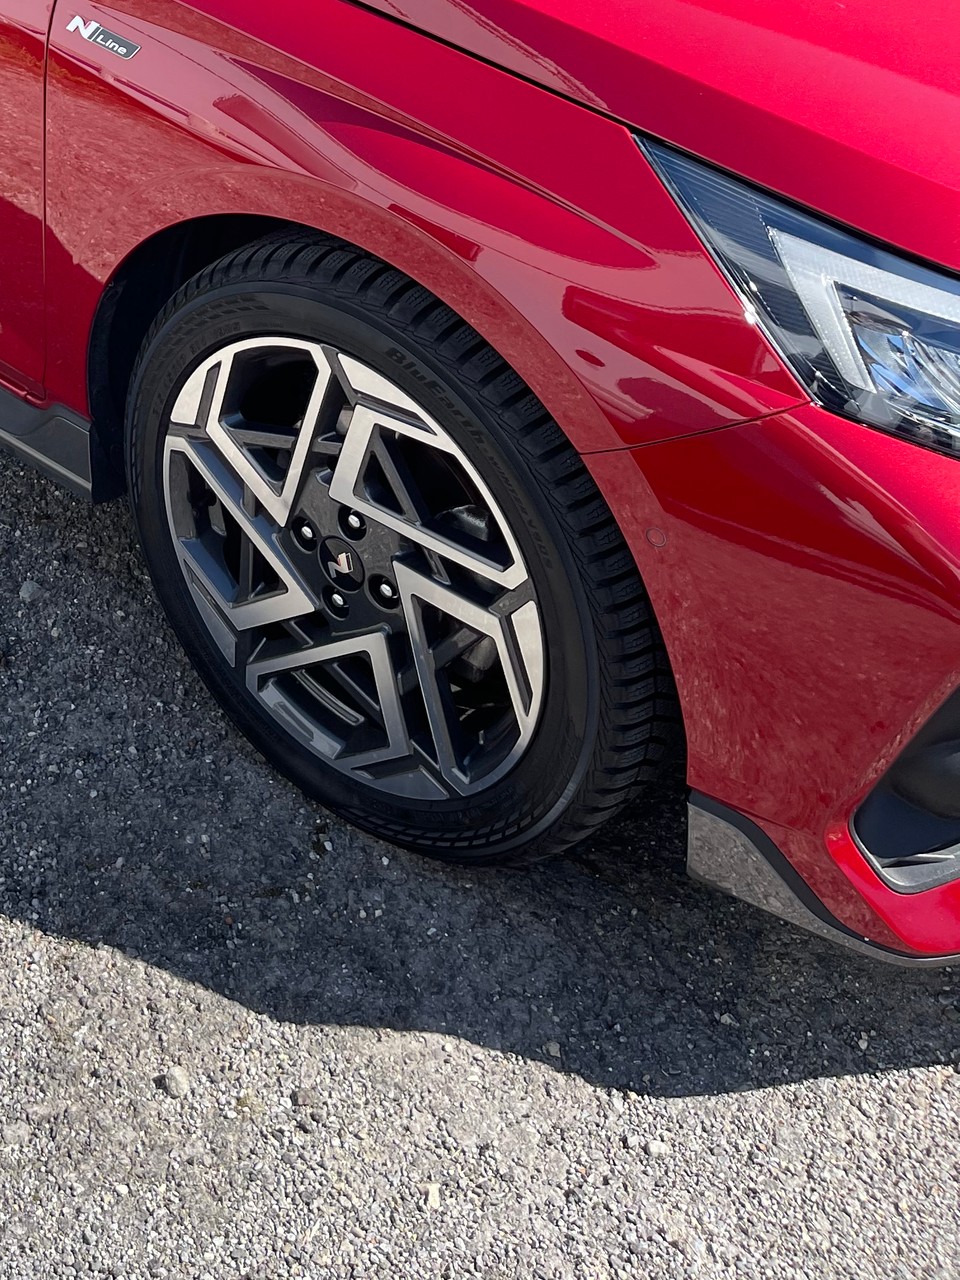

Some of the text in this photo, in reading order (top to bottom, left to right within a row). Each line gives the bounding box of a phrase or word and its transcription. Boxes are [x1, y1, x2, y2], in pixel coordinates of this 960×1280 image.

[66, 15, 127, 55] N Line
[384, 345, 485, 444] BluEarth
